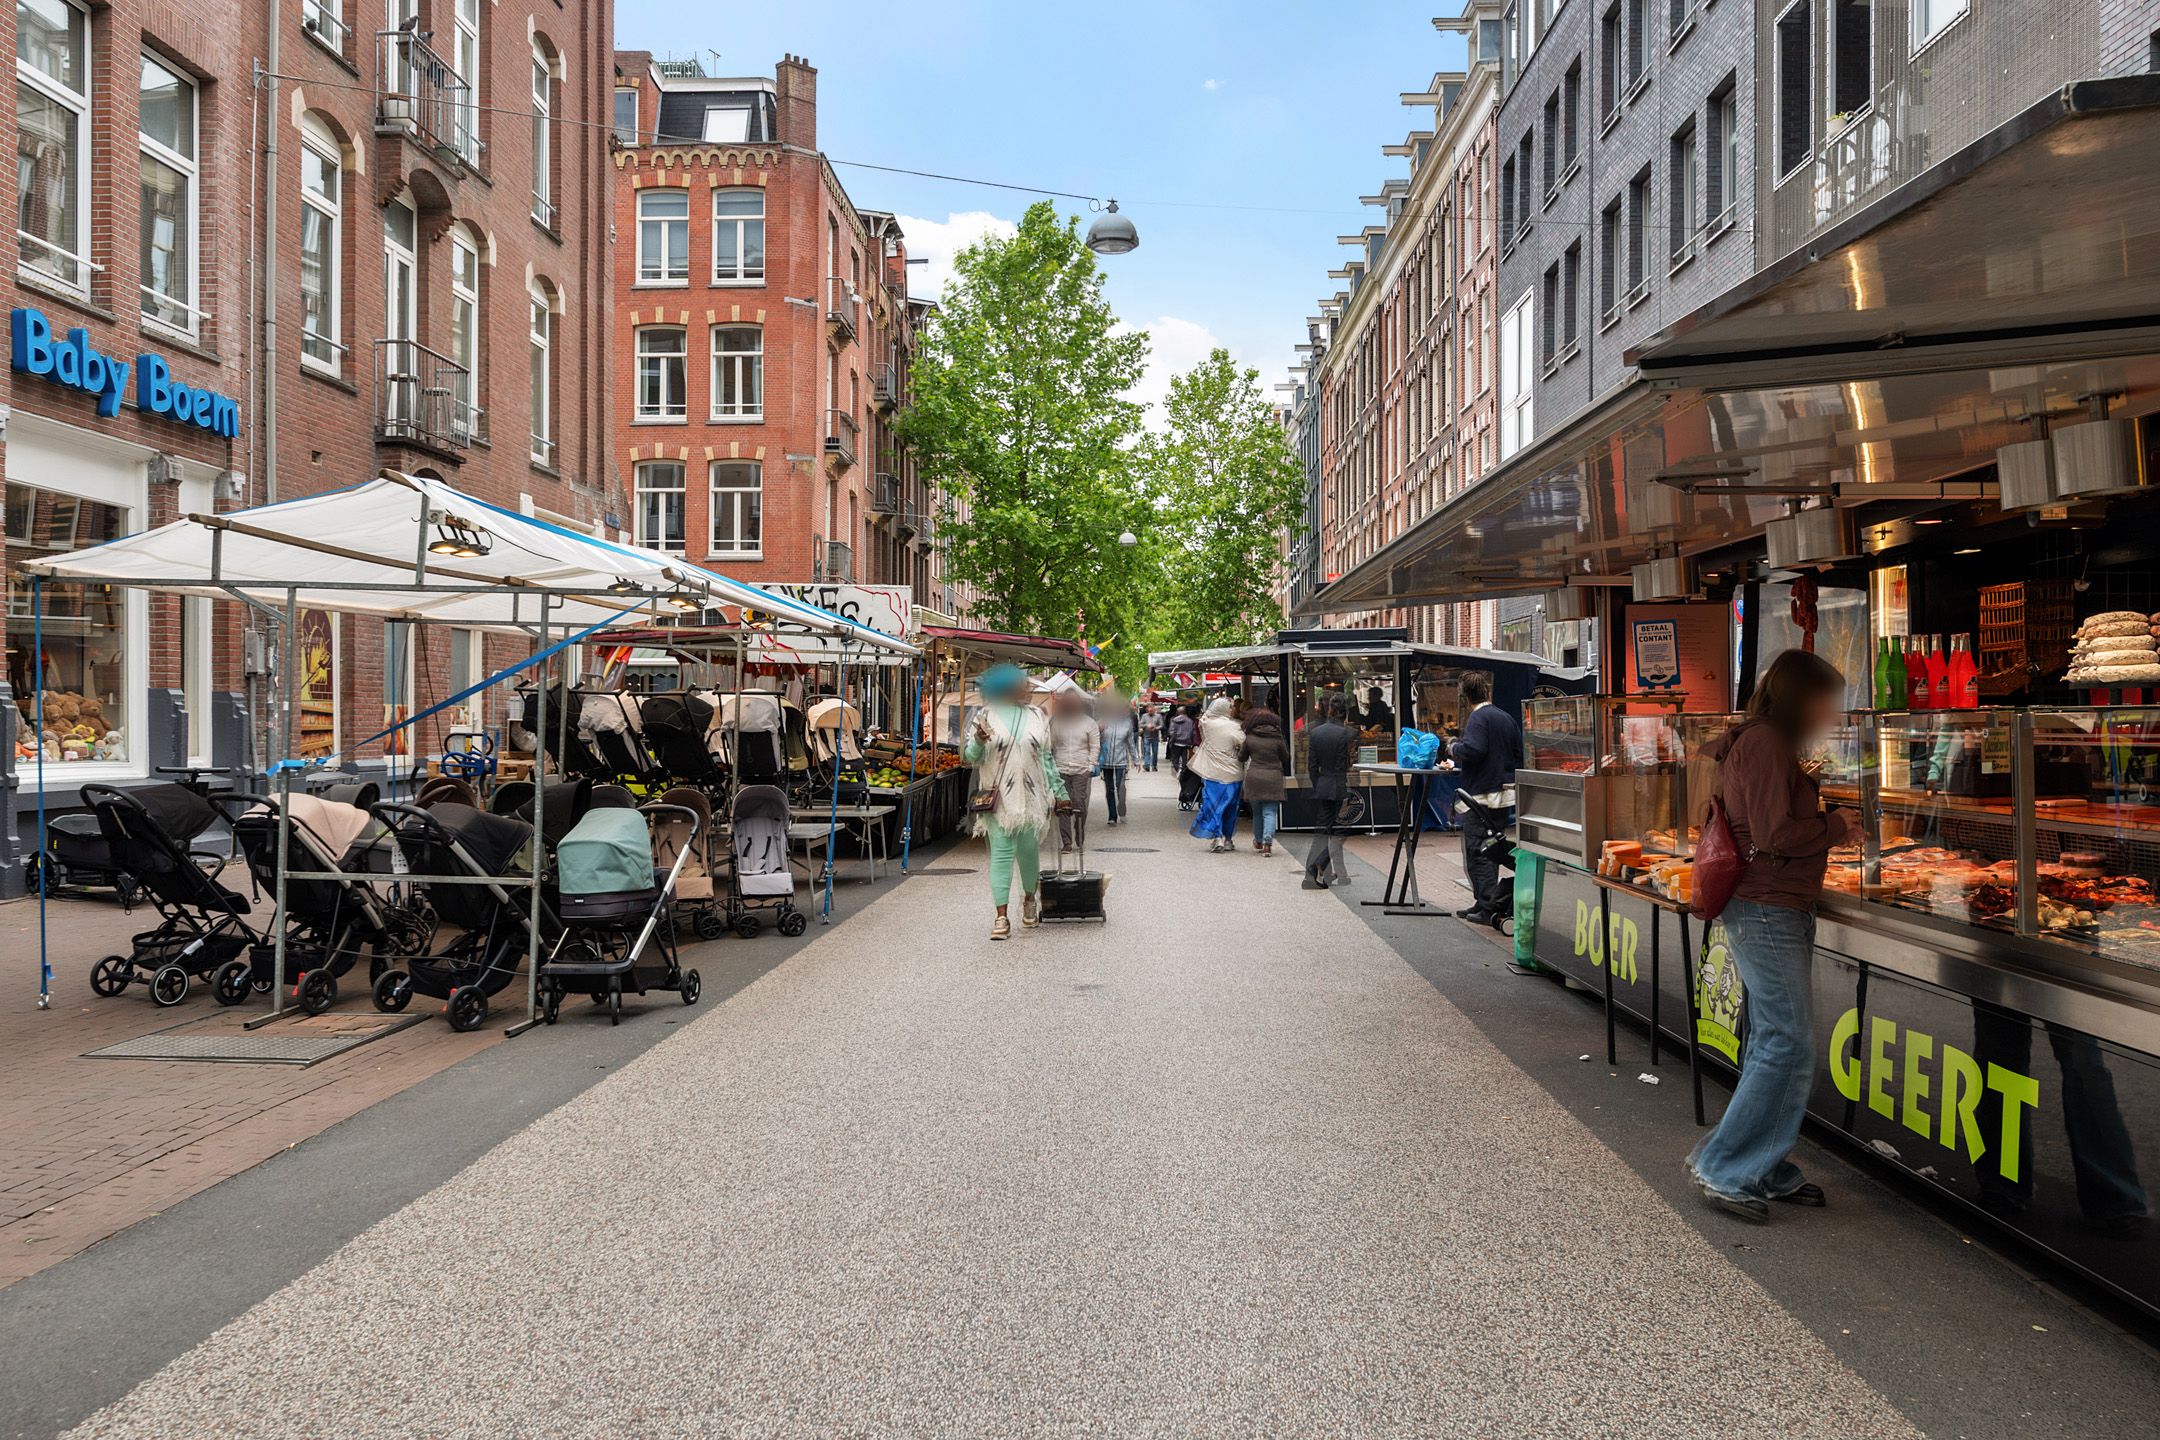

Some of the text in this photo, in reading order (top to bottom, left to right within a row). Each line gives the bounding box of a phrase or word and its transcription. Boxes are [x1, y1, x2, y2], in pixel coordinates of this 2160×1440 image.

[11, 308, 239, 438] Baby Boem
[1639, 634, 1673, 643] CONTANT
[1641, 624, 1669, 632] BETAAL
[1574, 898, 1638, 986] BOER
[1829, 1007, 2039, 1184] GEERT
